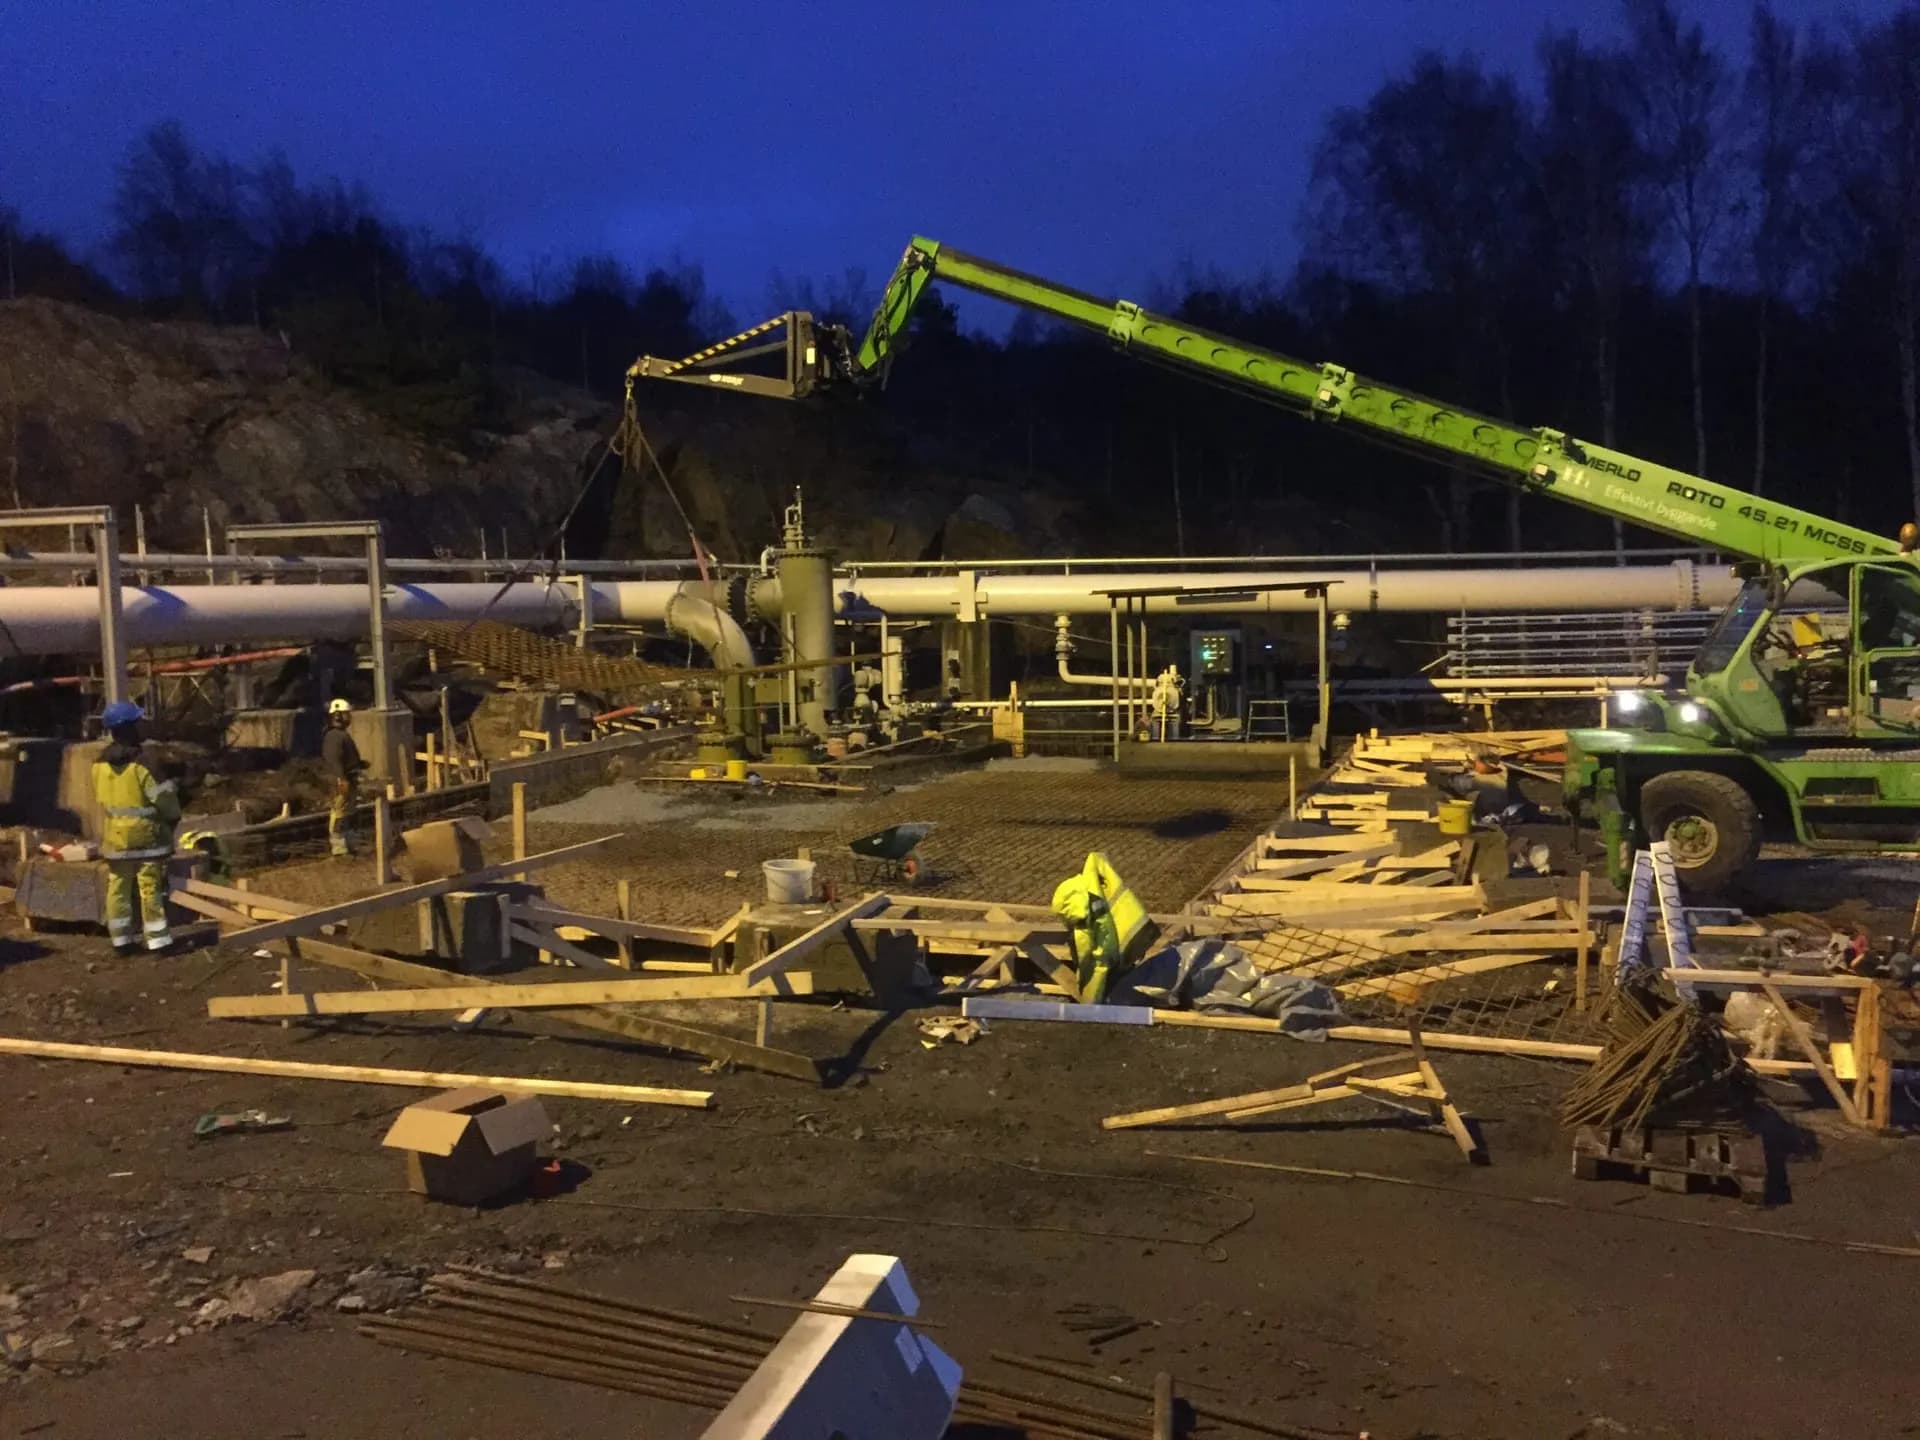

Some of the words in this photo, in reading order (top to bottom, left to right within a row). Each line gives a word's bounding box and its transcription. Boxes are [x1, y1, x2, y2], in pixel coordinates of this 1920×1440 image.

[1666, 481, 1726, 510] ROTO
[1738, 505, 1799, 534] 45.21
[1803, 524, 1867, 555] MCSS
